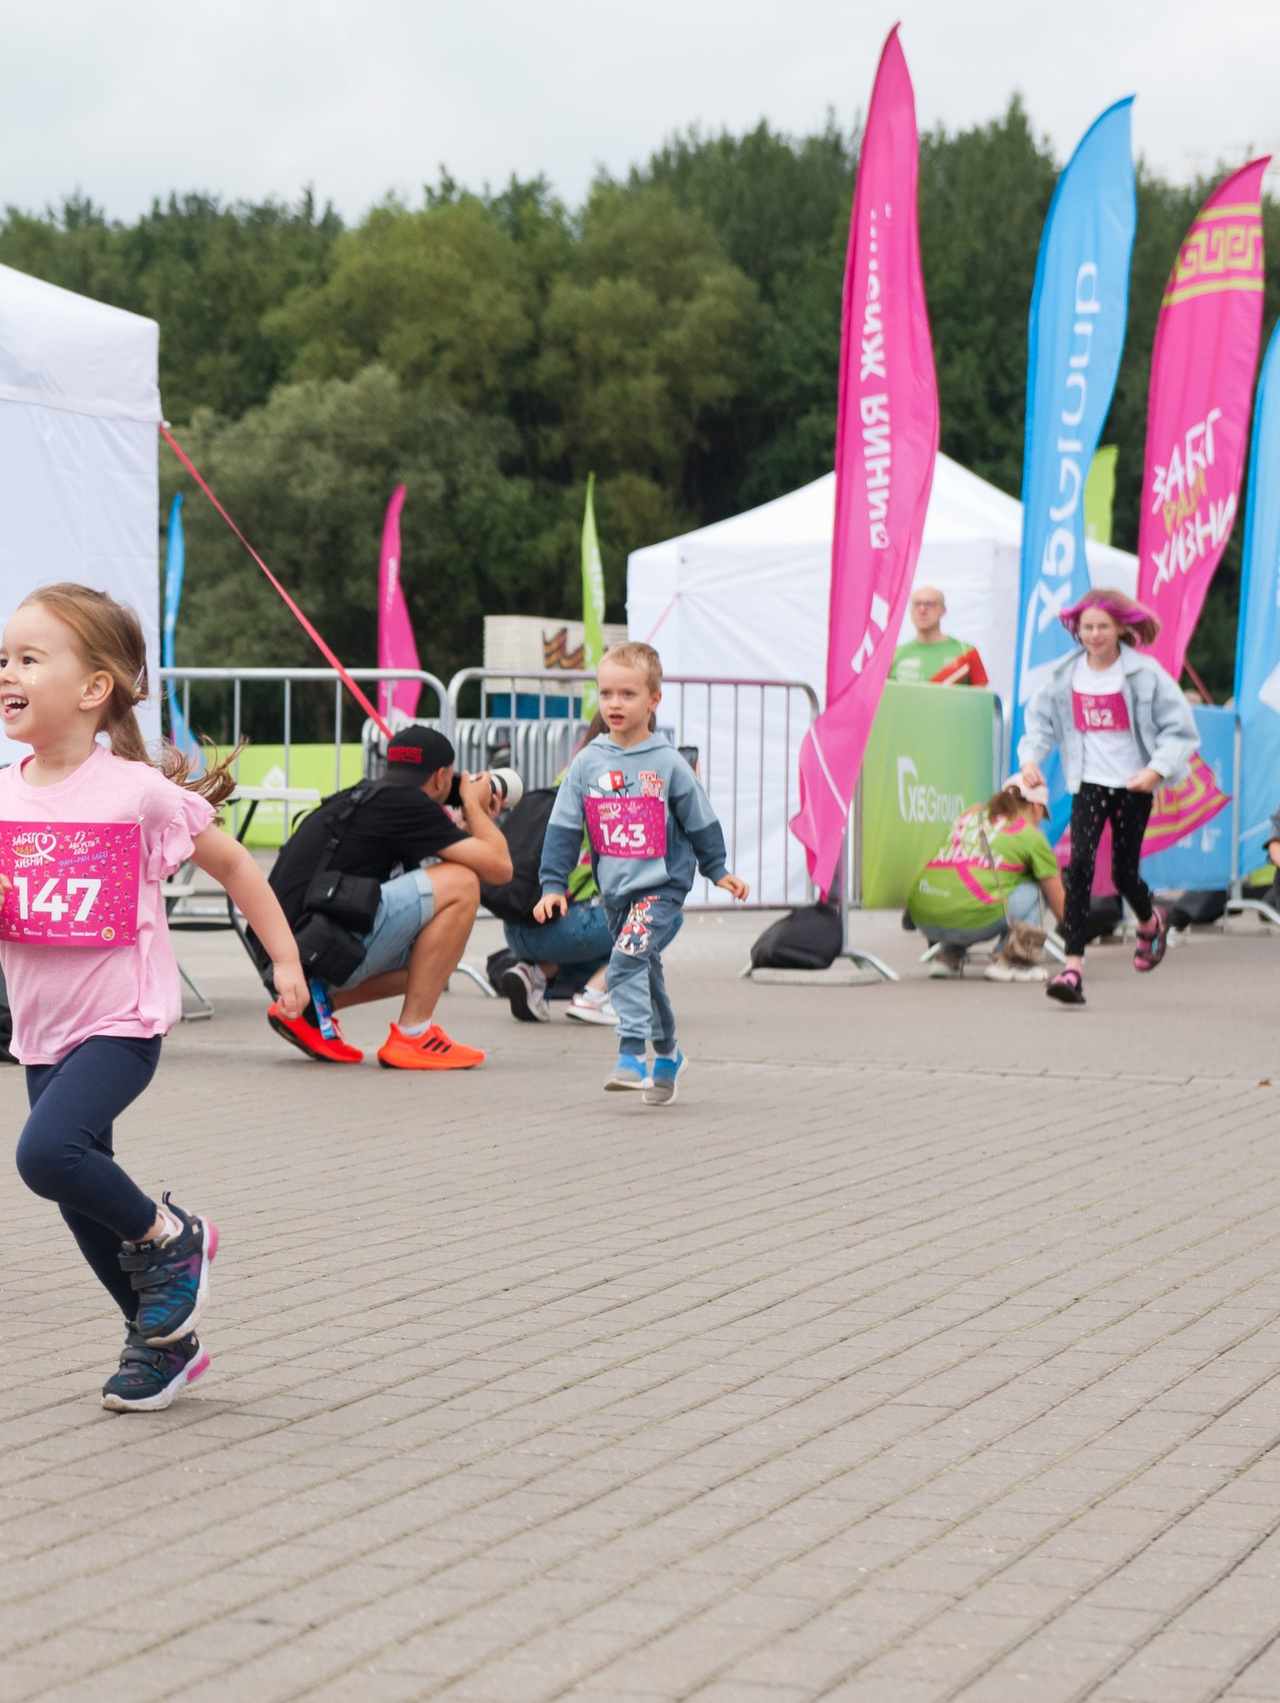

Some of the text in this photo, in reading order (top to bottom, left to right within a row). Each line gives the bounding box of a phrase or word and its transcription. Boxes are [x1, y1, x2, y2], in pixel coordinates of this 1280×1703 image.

[1082, 708, 1115, 726] 152
[12, 832, 36, 845] ЗАБЕГ
[74, 831, 86, 841] 13
[600, 823, 646, 848] 143
[13, 876, 102, 922] 147
